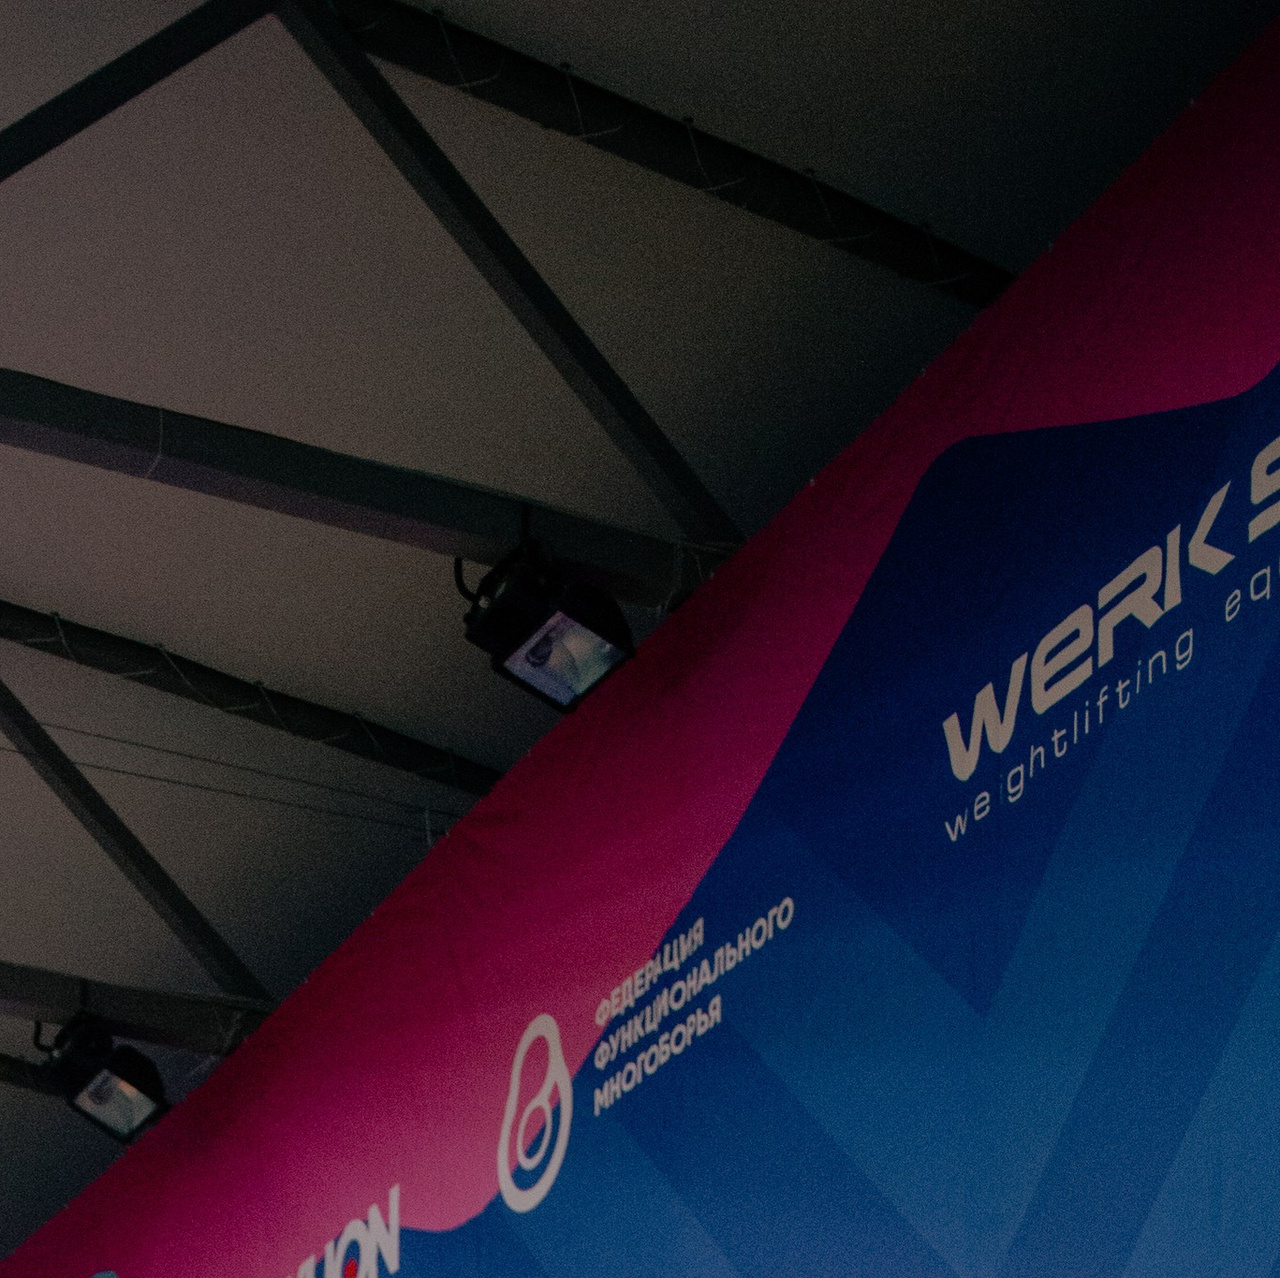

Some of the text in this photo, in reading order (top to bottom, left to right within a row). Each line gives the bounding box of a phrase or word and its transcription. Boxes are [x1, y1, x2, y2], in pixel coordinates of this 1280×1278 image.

[944, 556, 1280, 842] weghtlifting eq
[594, 897, 794, 1070] ФУНКЦИОНАЛЬНОГО
[595, 917, 704, 1027] ФЕДЕРАЦИЯ
[594, 994, 722, 1117] МНОГОБОРЬЯ
